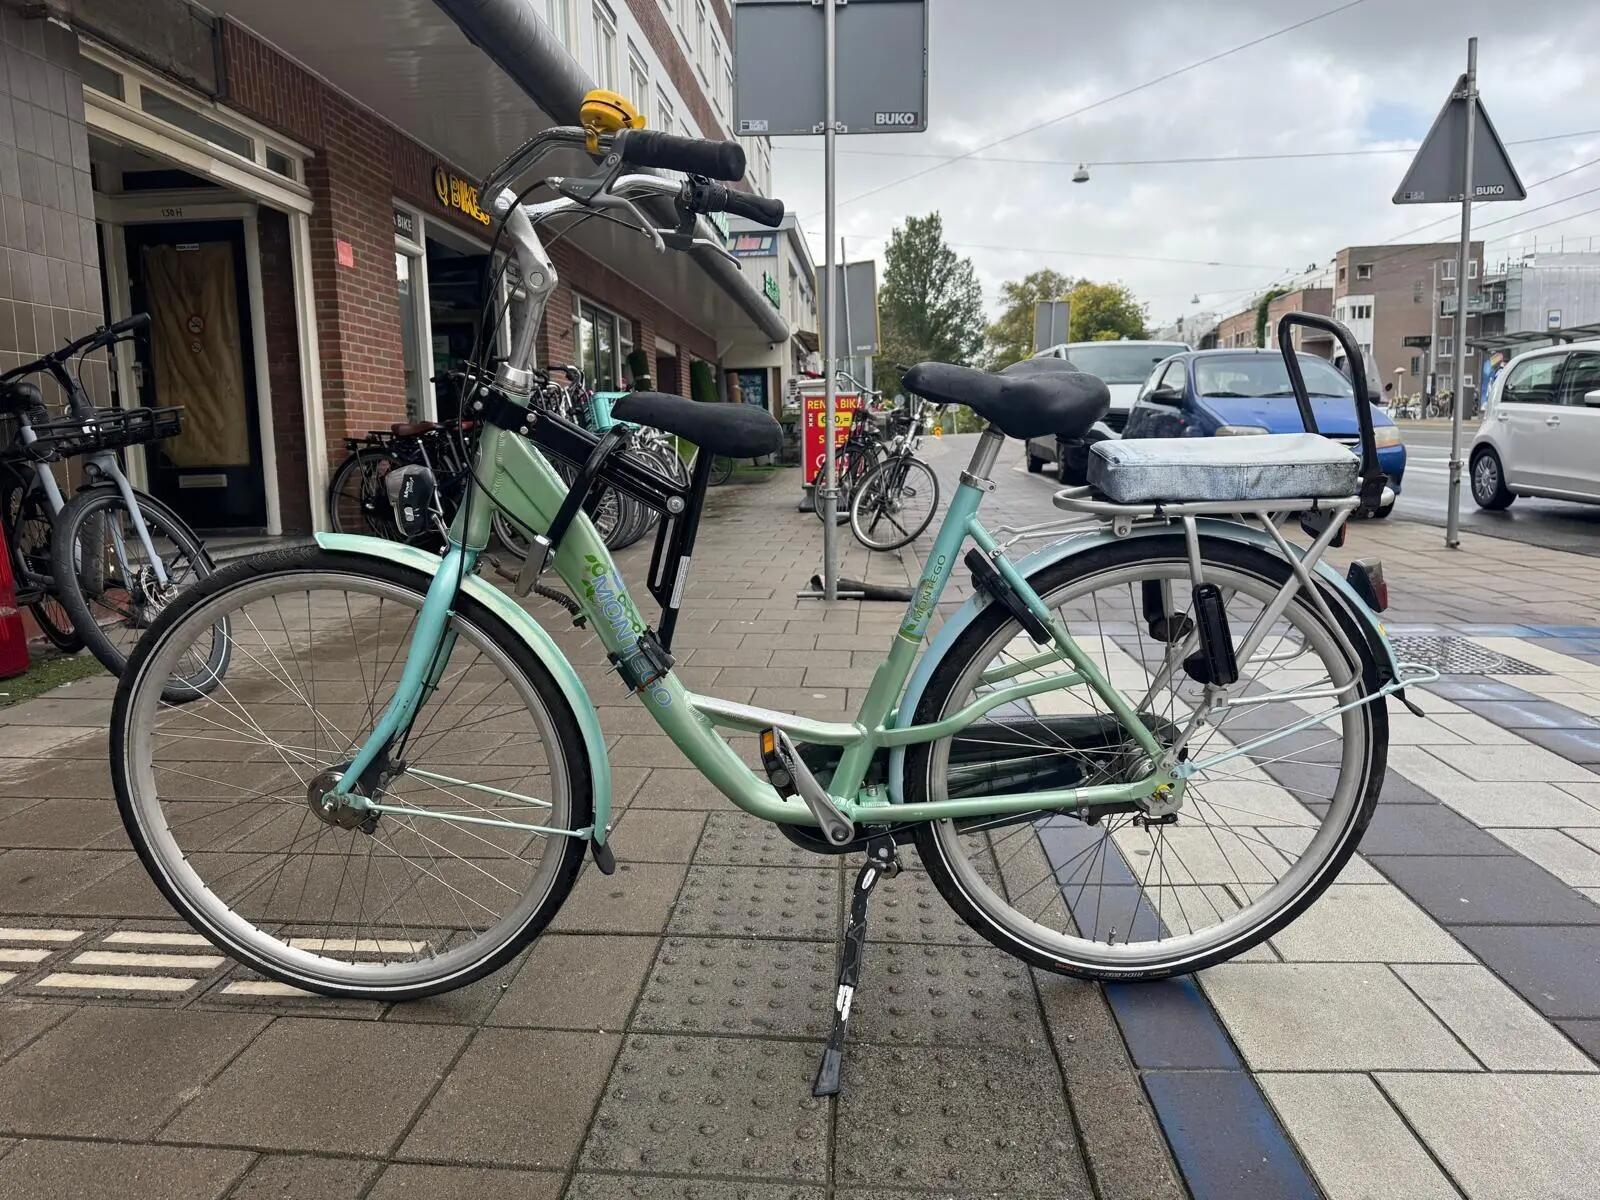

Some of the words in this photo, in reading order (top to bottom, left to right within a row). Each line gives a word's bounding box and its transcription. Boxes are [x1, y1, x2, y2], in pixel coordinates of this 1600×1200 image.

[875, 112, 914, 125] BUKO
[435, 167, 449, 206] Q
[1476, 185, 1504, 196] BUKO
[397, 214, 412, 232] BIKE
[807, 399, 827, 410] REN
[820, 415, 850, 425] €0,=
[912, 554, 946, 623] MONTEGO
[592, 574, 672, 708] MONTEGO
